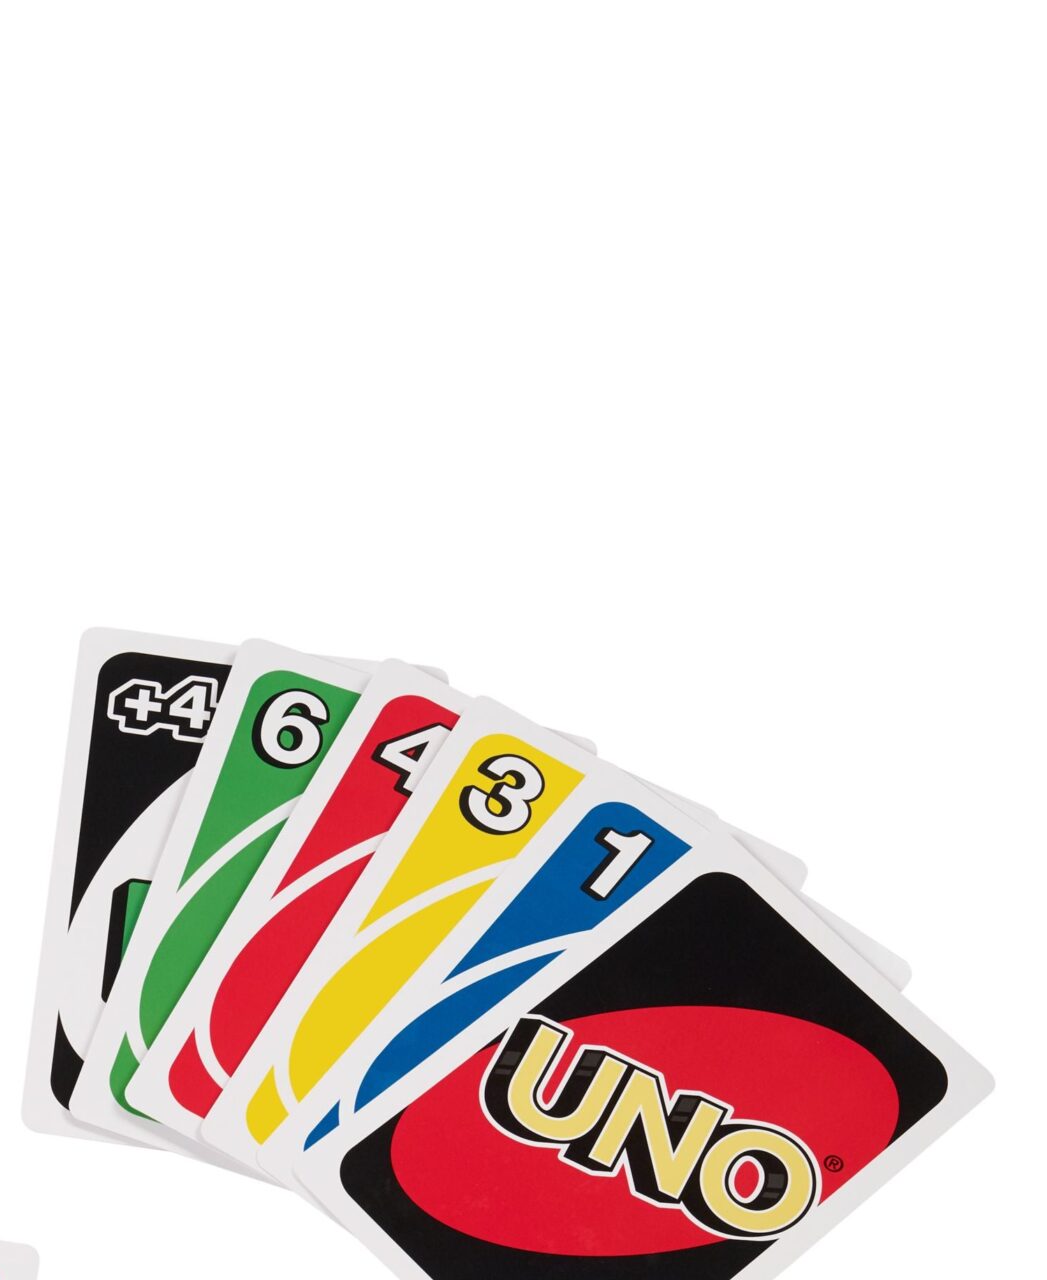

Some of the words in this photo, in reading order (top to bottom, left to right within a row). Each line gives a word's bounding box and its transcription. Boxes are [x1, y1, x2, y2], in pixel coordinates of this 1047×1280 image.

[119, 680, 214, 736] +4
[253, 688, 330, 769] 6
[372, 723, 451, 797] 4
[459, 754, 545, 835] 3
[581, 827, 654, 901] 1
[485, 1018, 818, 1237] UNO
